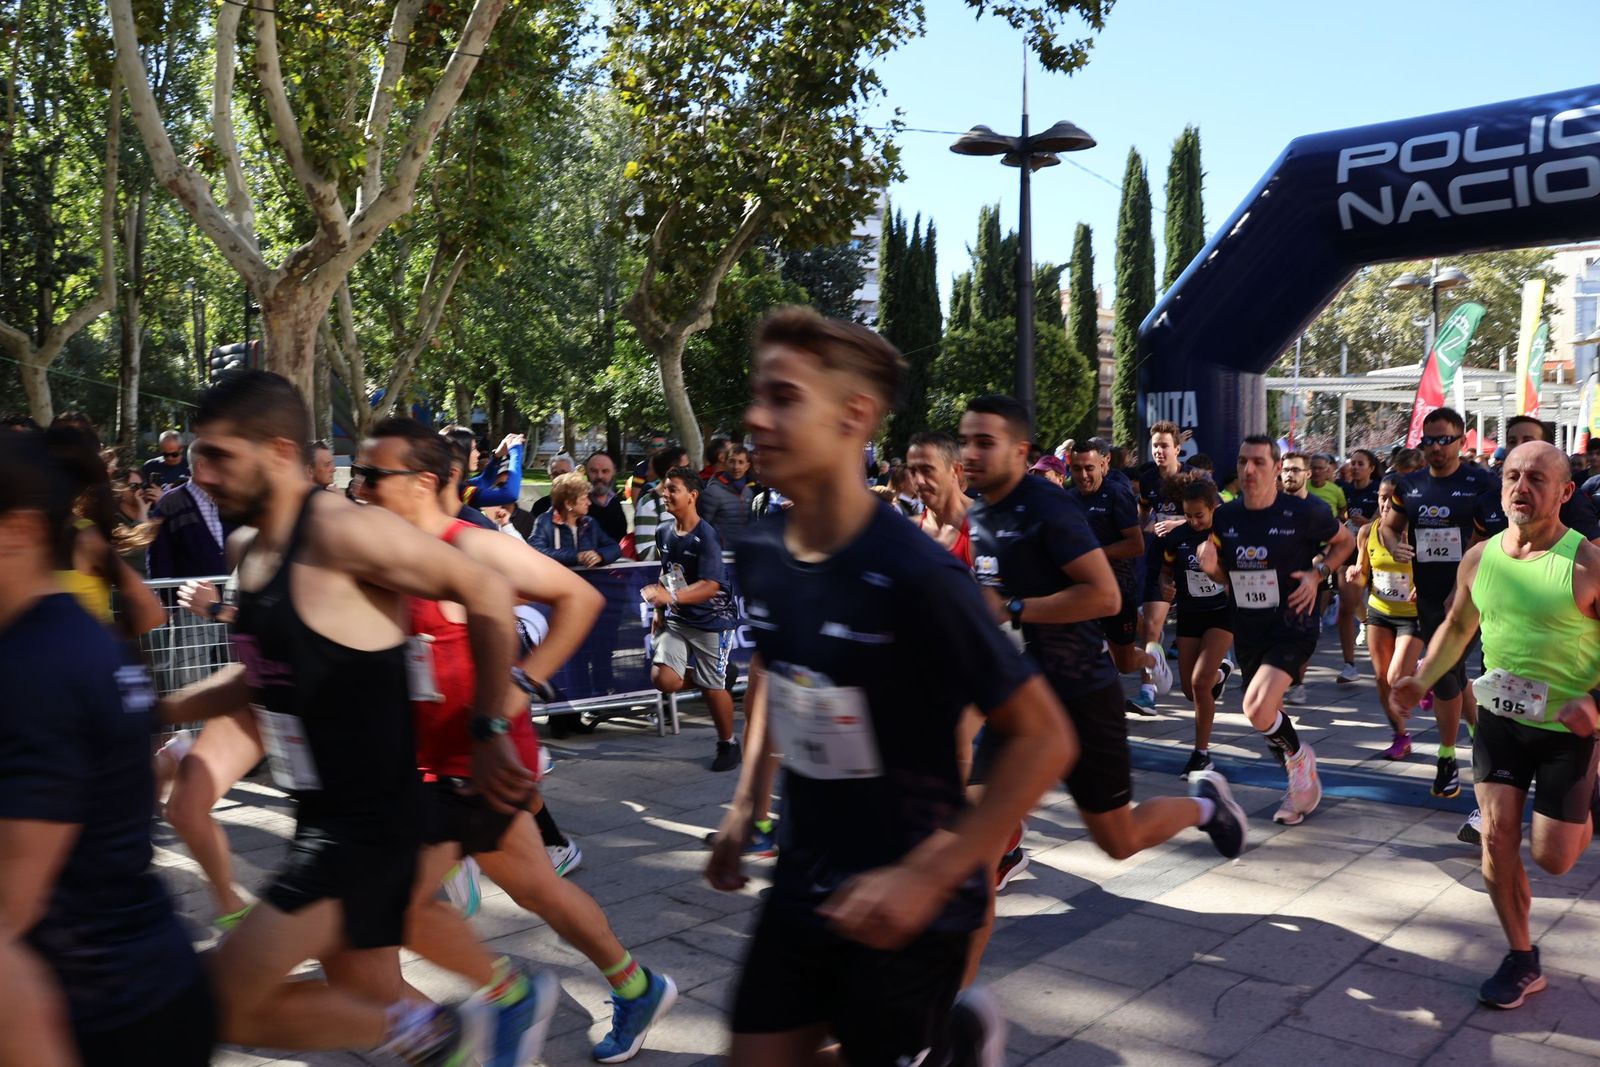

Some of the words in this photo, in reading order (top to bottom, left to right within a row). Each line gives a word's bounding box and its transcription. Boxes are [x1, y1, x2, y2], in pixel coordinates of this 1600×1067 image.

[1337, 105, 1600, 184] POLIC
[1337, 155, 1600, 230] NACIO
[1146, 390, 1199, 428] RUTA
[1426, 547, 1449, 556] 142
[1245, 592, 1267, 602] 138
[1492, 697, 1526, 714] 195
